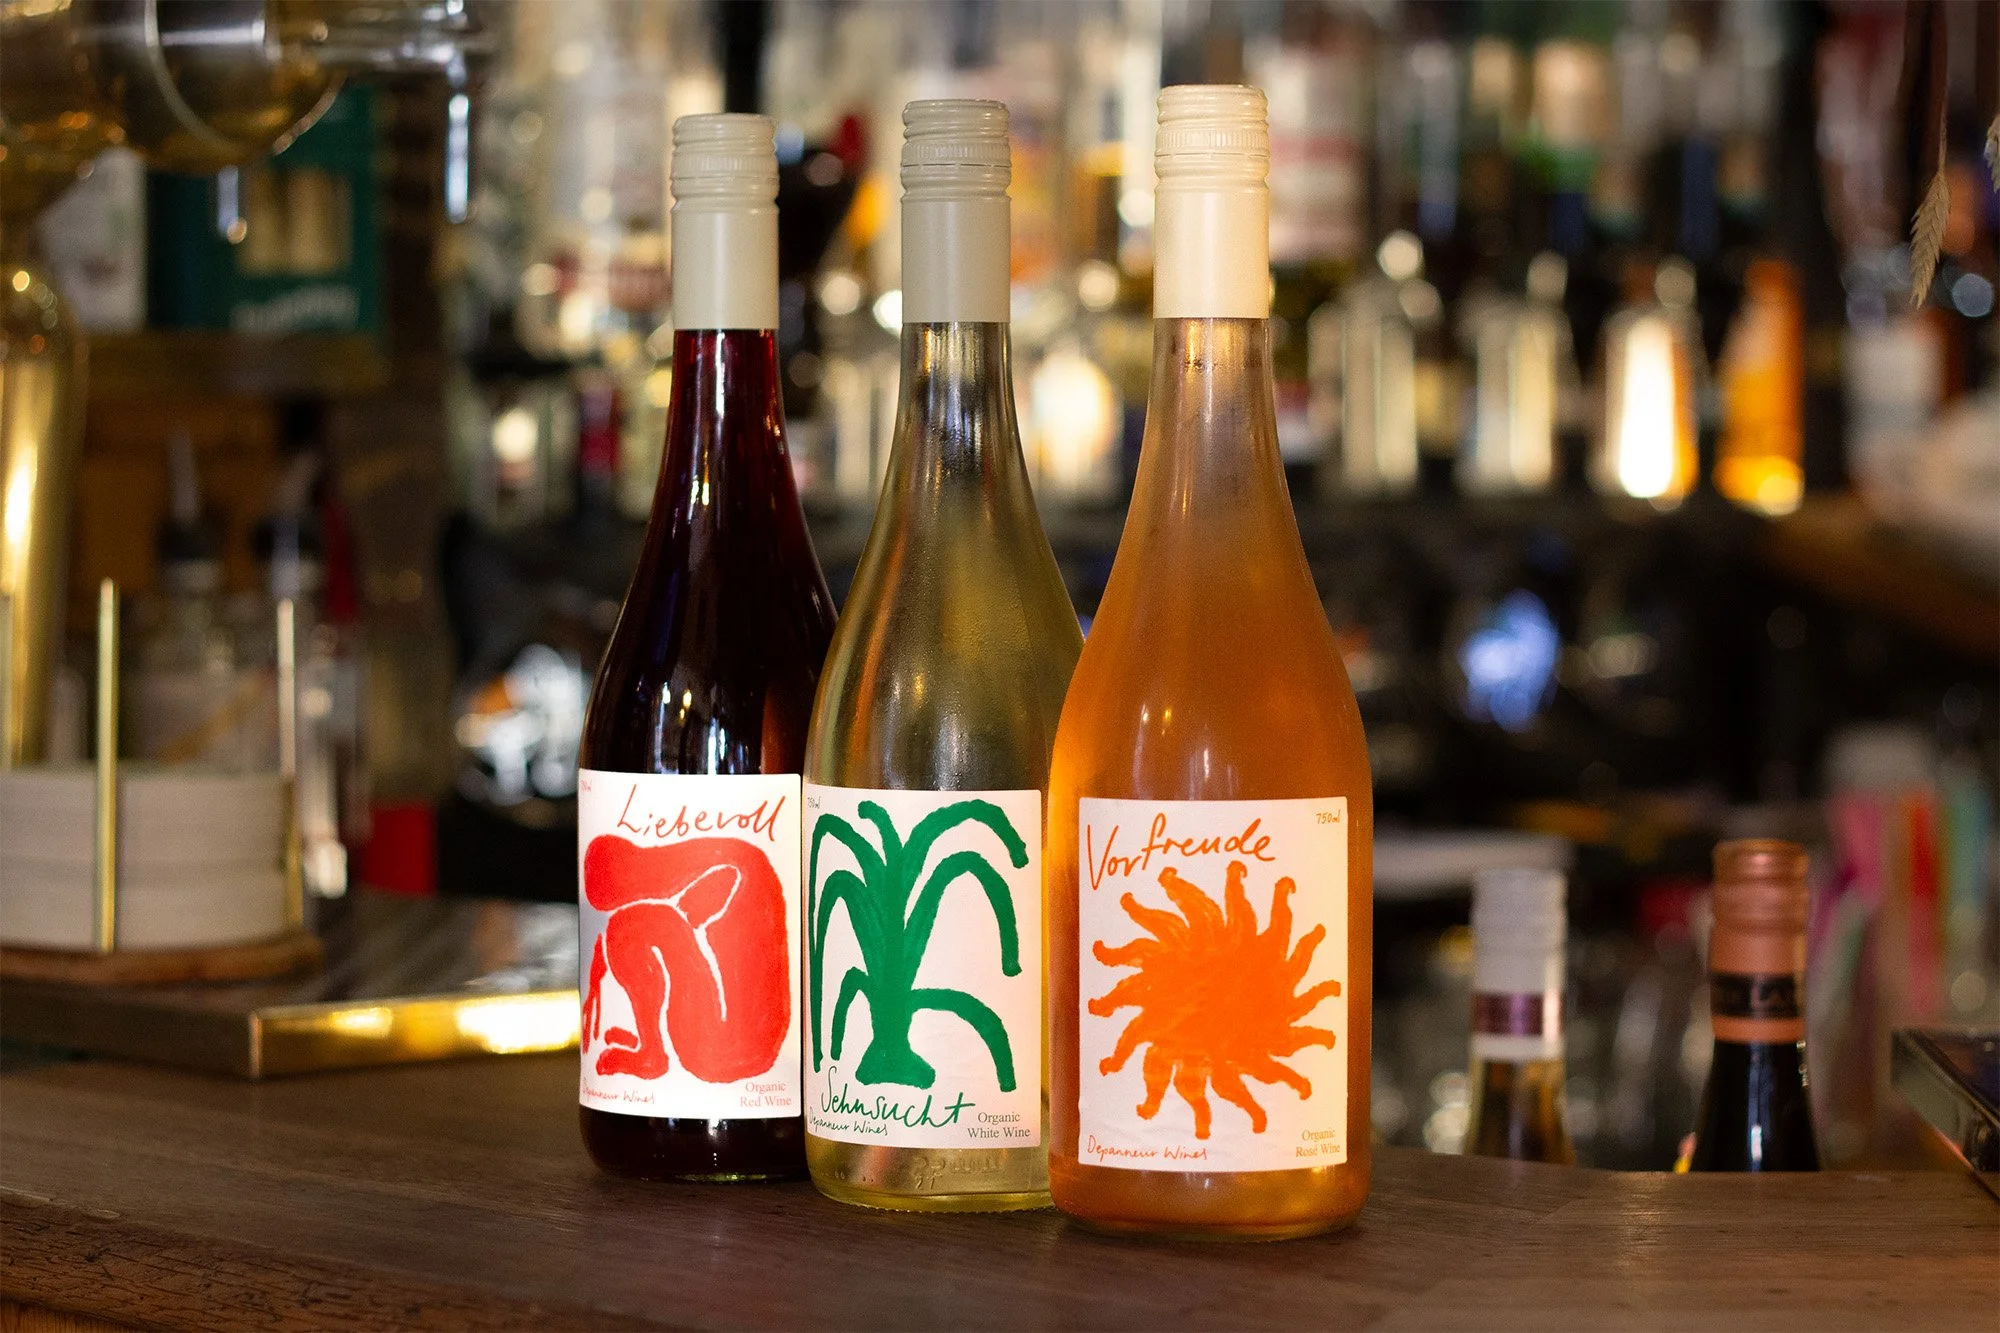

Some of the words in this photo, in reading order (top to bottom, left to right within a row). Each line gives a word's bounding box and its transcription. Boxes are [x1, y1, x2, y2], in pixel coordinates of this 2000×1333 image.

[617, 784, 786, 841] Liebevoll
[1315, 808, 1341, 824] 750ml
[1087, 813, 1276, 890] Vorfreude
[745, 1080, 786, 1094] Organic
[740, 1096, 761, 1107] Red
[764, 1095, 792, 1106] Wine
[820, 1066, 976, 1127] Sehnsucht
[977, 1111, 1021, 1125] Organic
[853, 1120, 888, 1136] Wines
[967, 1127, 1000, 1138] White
[1003, 1126, 1031, 1138] Wine
[1301, 1128, 1336, 1142] Organic
[1164, 1144, 1208, 1161] Wines
[1320, 1142, 1341, 1155] Wine
